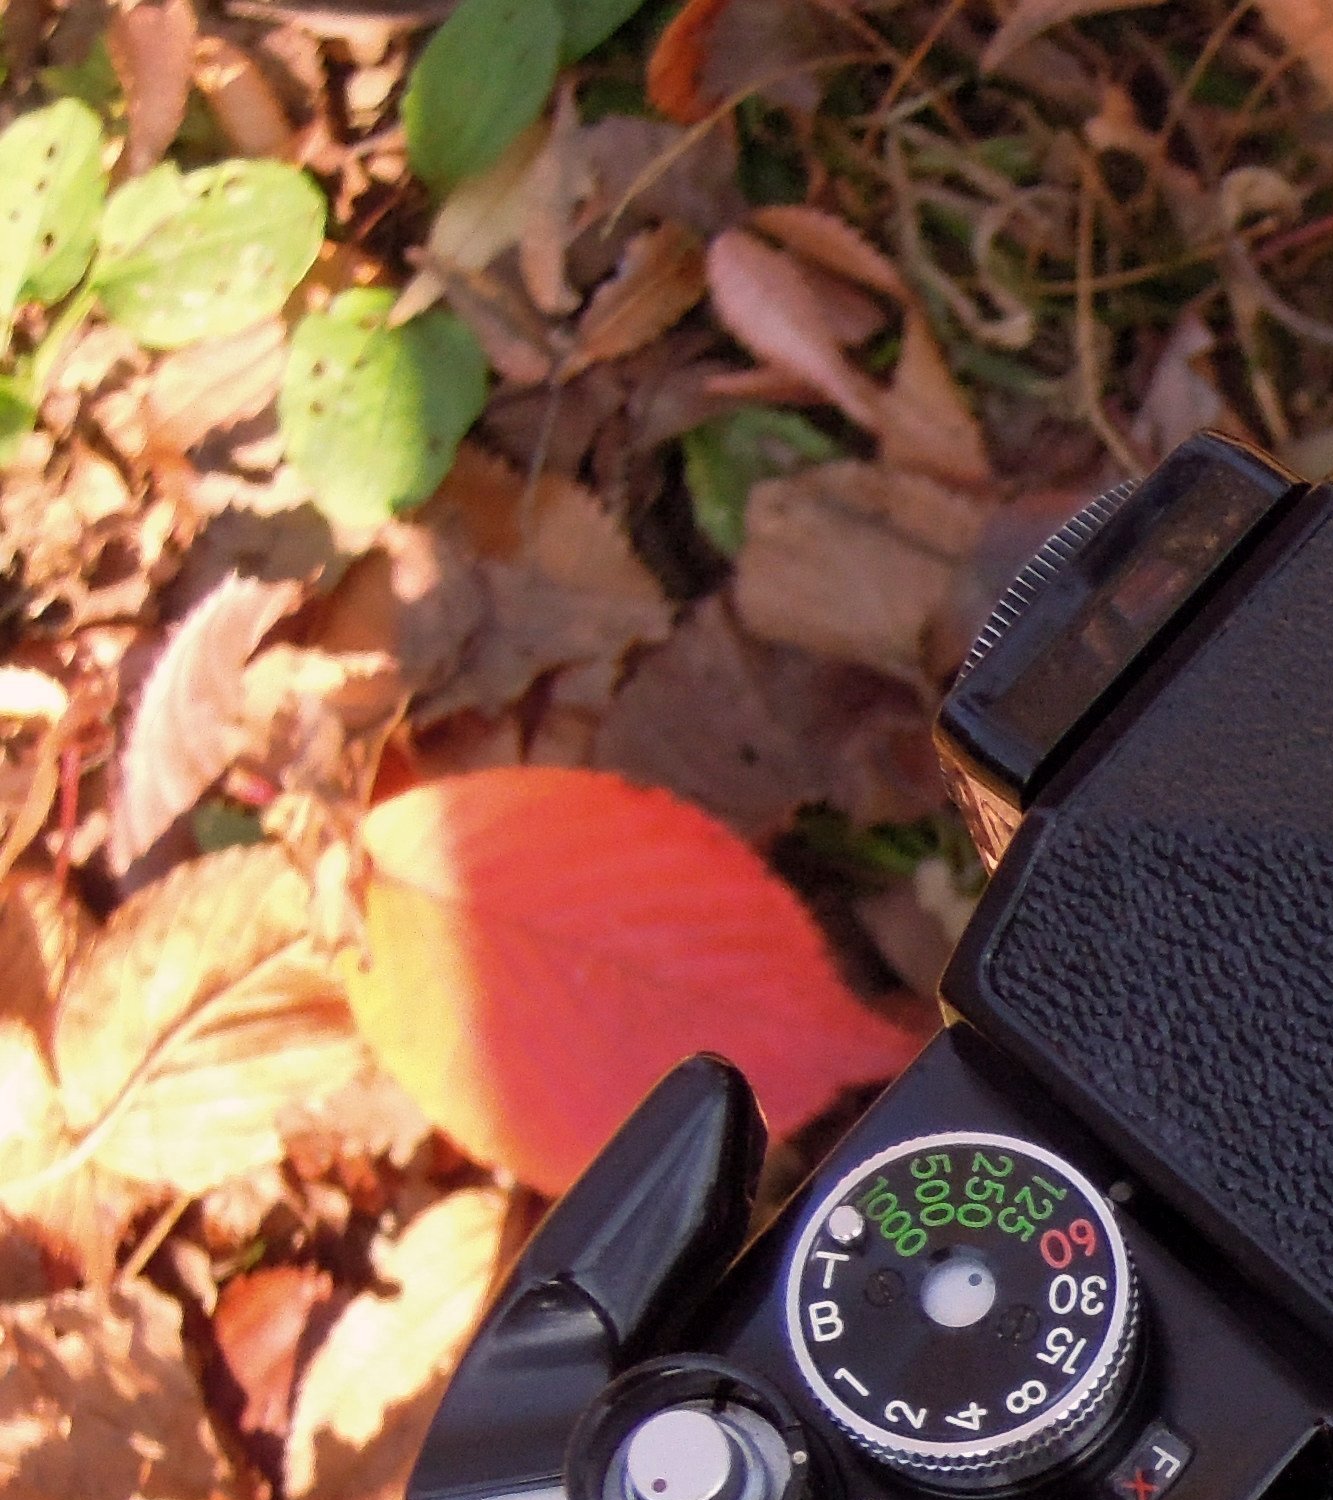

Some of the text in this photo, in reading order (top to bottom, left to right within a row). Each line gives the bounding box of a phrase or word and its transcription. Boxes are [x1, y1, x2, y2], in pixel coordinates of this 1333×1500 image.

[911, 1152, 955, 1227] 500
[956, 1152, 1014, 1229] 250
[997, 1175, 1067, 1242] 125
[861, 1176, 928, 1258] 1000
[1039, 1217, 1097, 1270] 60
[814, 1250, 850, 1289] T
[1048, 1273, 1108, 1316] 30
[808, 1301, 845, 1342] B
[1036, 1326, 1088, 1374] 15
[833, 1367, 870, 1398] 1
[1005, 1379, 1048, 1415] 8
[883, 1399, 928, 1430] 2
[944, 1401, 988, 1431] 4
